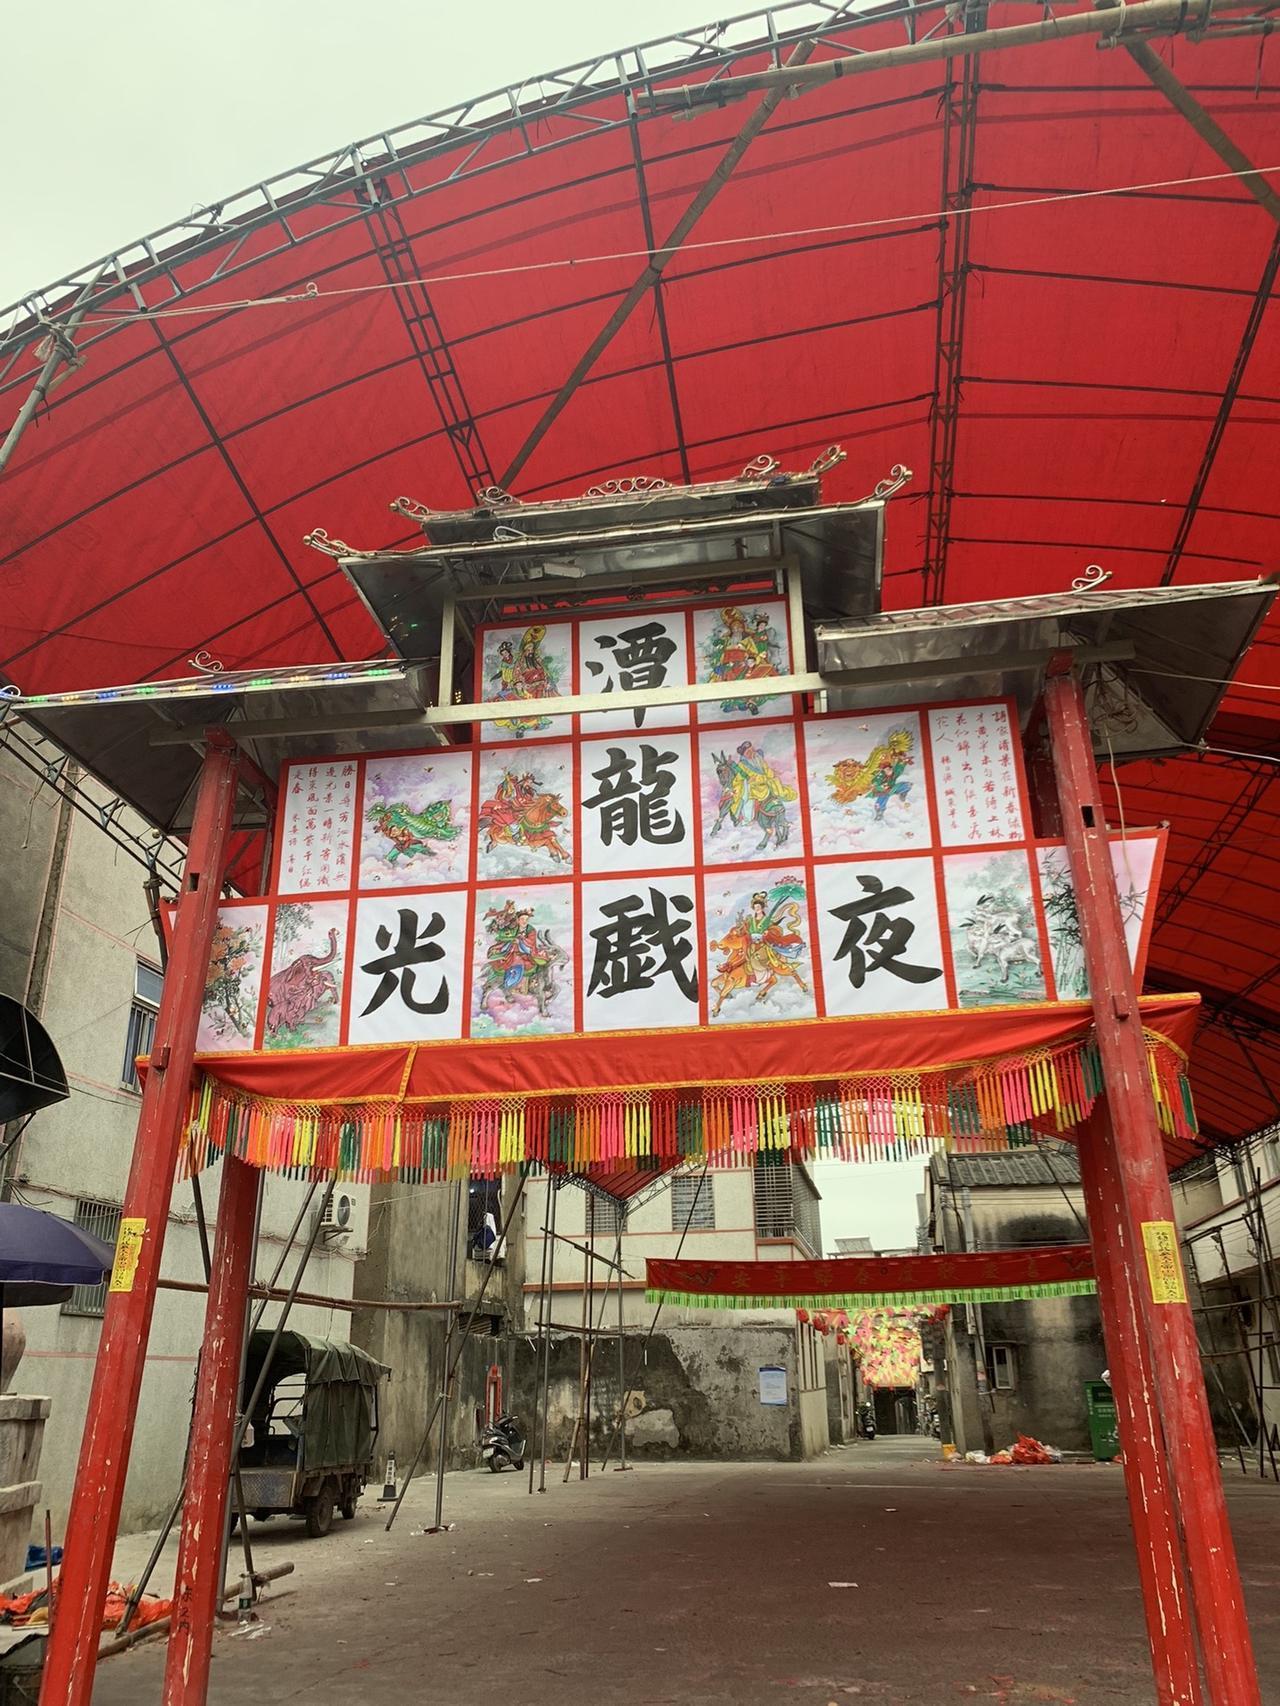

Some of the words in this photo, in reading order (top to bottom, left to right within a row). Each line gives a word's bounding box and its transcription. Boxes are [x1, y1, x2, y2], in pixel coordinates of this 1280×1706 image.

[581, 744, 686, 846] 龍
[358, 908, 450, 1018] 光
[827, 875, 943, 989] 夜
